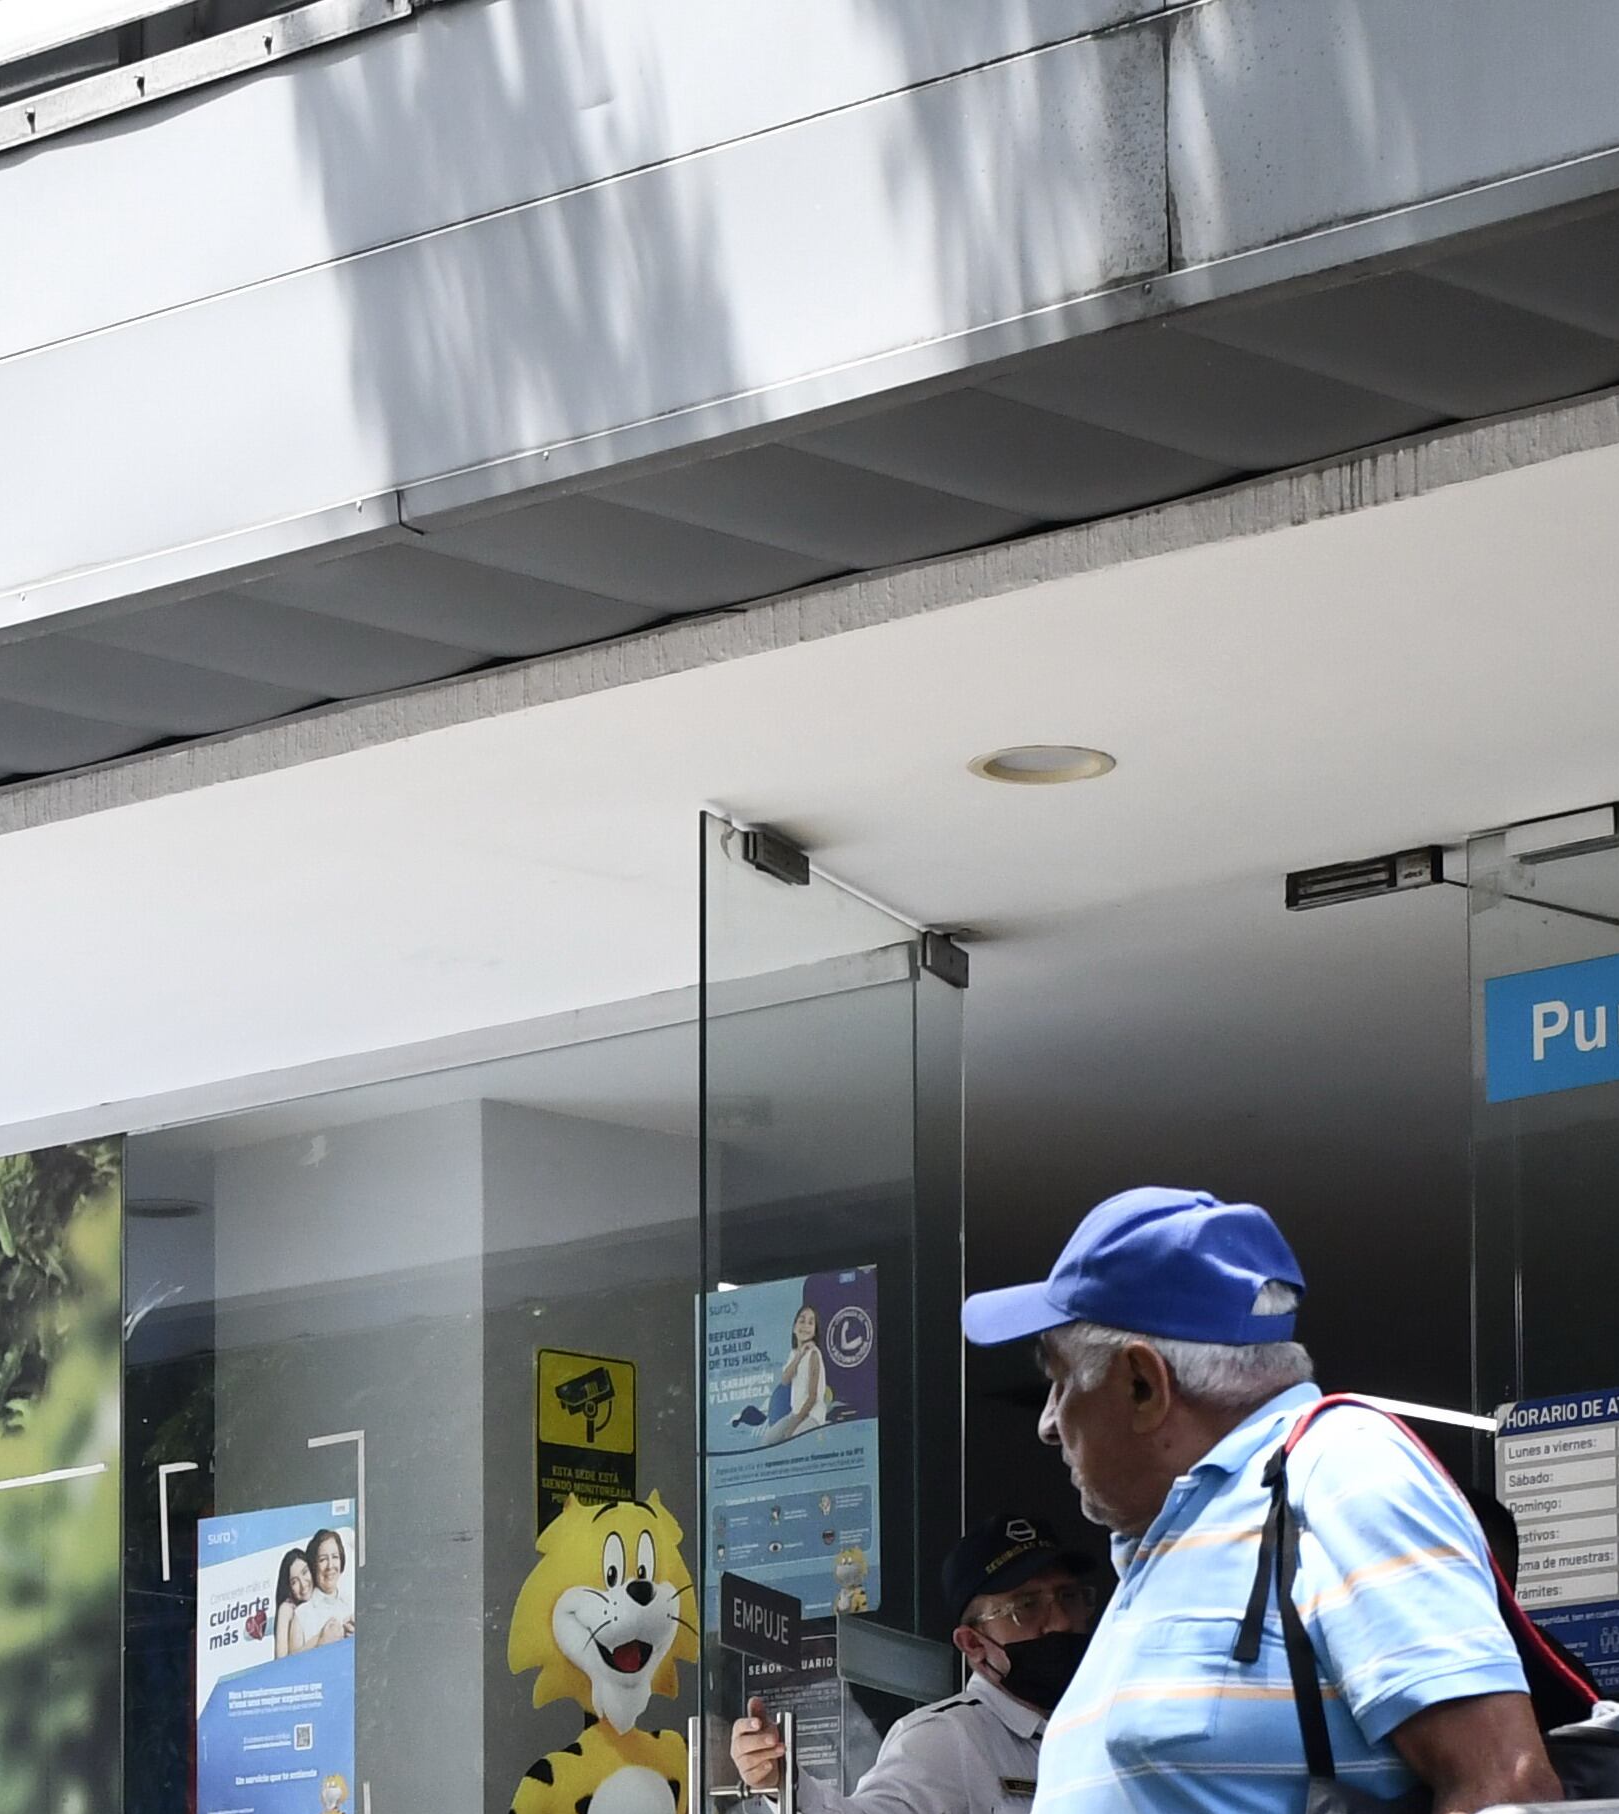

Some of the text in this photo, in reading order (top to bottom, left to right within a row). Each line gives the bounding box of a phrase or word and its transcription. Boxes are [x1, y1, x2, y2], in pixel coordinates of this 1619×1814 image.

[1506, 1402, 1578, 1430] HORARIO
[1582, 1399, 1603, 1419] DE
[1509, 1438, 1597, 1459] Lunes a viernes:
[1509, 1472, 1553, 1487] Sábado:
[1509, 1500, 1561, 1514] Domingo:
[207, 1531, 230, 1545] sura
[1518, 1551, 1615, 1572] oma de muestras:
[1517, 1586, 1562, 1599] rámites:
[209, 1597, 269, 1627] cuidarte
[733, 1596, 789, 1645] EMPUJE
[209, 1625, 239, 1650] más
[801, 1656, 834, 1670] UARIO
